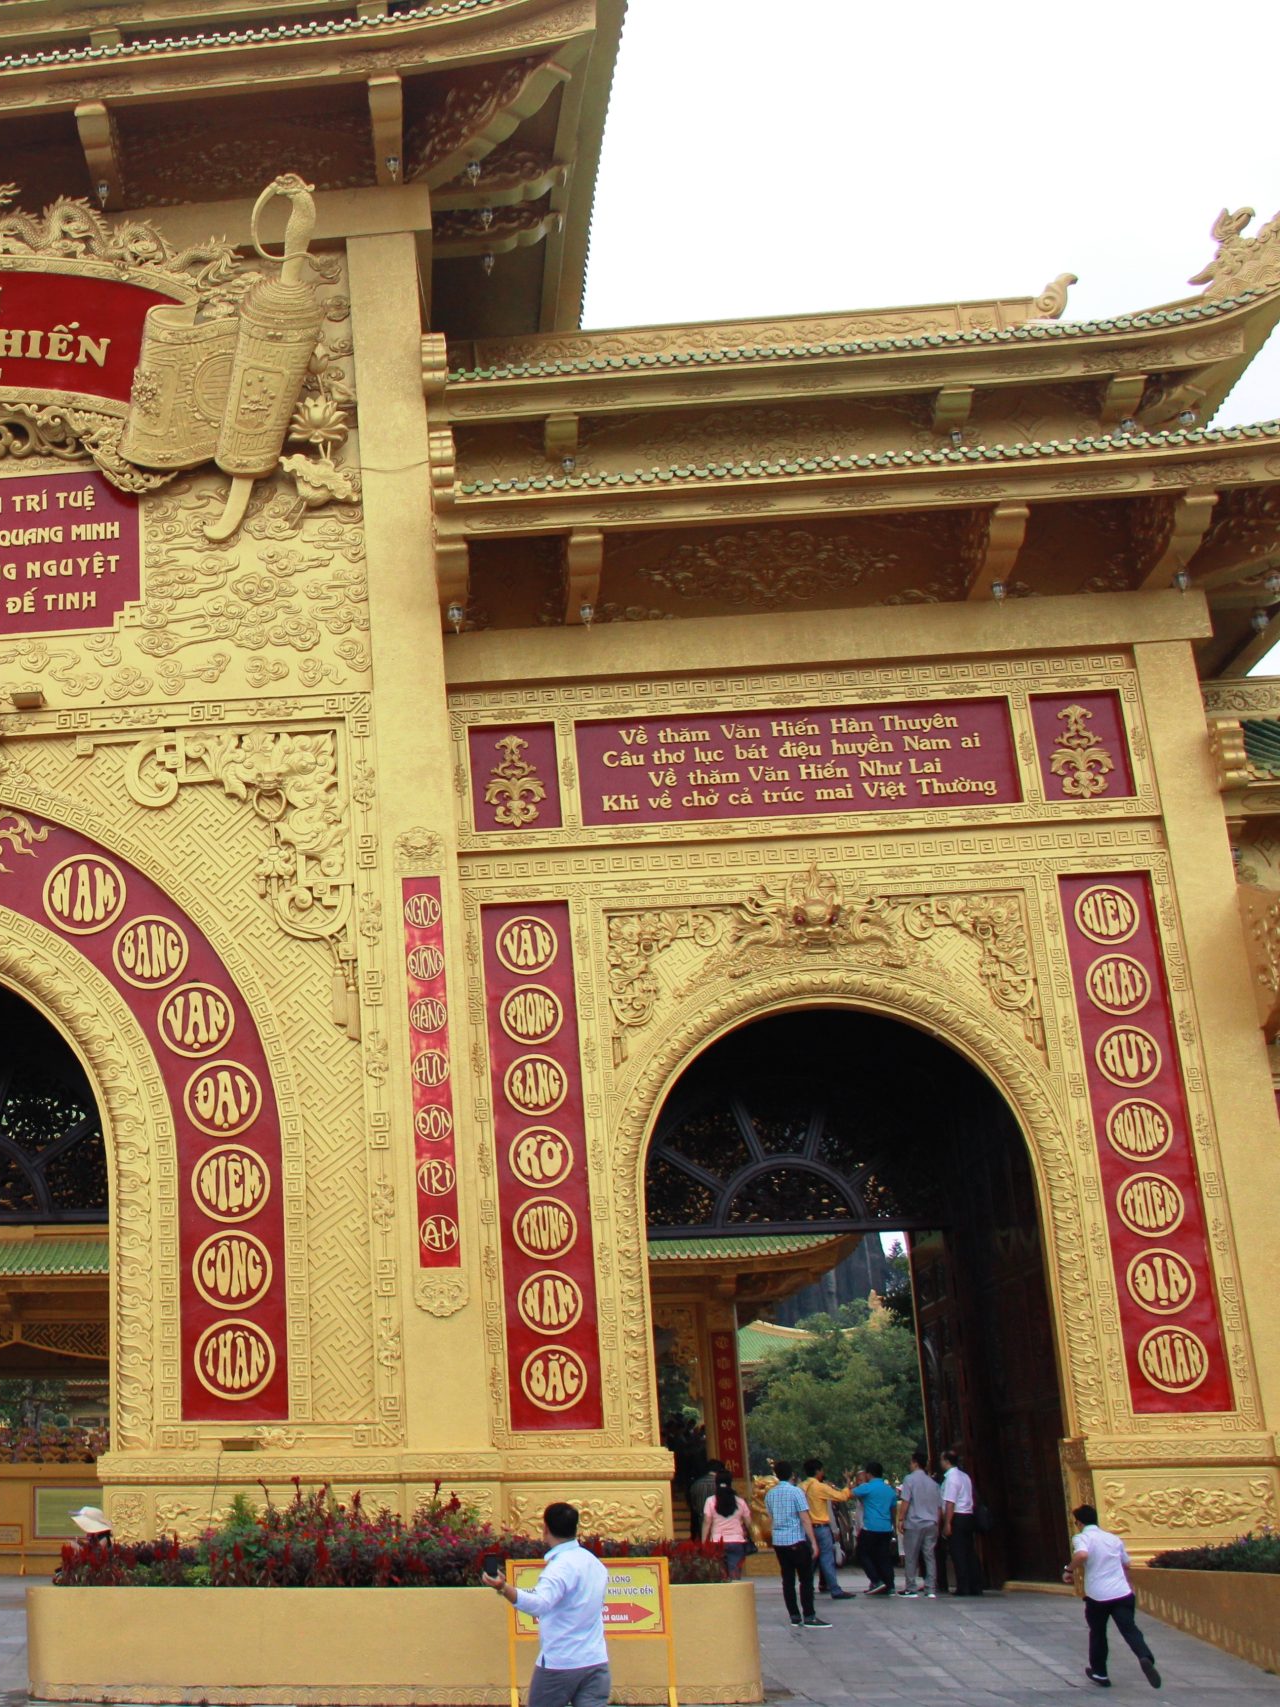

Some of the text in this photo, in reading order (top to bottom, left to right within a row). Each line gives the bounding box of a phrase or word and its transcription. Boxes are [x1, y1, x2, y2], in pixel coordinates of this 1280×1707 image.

[11, 489, 47, 512] TRÍ
[56, 485, 95, 510] TUỆ
[71, 521, 119, 540] MINH
[27, 551, 120, 579] NGUYỆT
[6, 587, 37, 614] ĐẾ
[43, 591, 96, 611] TINH
[603, 732, 981, 767] Câu thơ lục bát điệu huyền Nam ai
[618, 713, 959, 745] Về thăm Văn Hiến Hàn Thuyên
[602, 777, 997, 811] Khi về chở cả trúc mai Việt Thường
[648, 758, 942, 787] Về thăm Văn Hiến Như Lai
[51, 864, 116, 922] NAM
[1082, 892, 1131, 936] HIẾN
[122, 924, 181, 978] BANG
[167, 991, 225, 1049] VẠN
[1103, 1033, 1151, 1078] HUY
[195, 1071, 250, 1128] ĐẠI
[1114, 1105, 1165, 1152] HOÀNG
[200, 1153, 262, 1212] NIỆM
[503, 923, 580, 1401] VĂN PHONG RẠNG RỠ TRUNG NAM BẮC
[1124, 1181, 1177, 1228] THIÊN
[202, 1240, 262, 1297] CÔNG
[1135, 1257, 1187, 1305] ĐỊA
[1145, 1333, 1202, 1383] NHÂN
